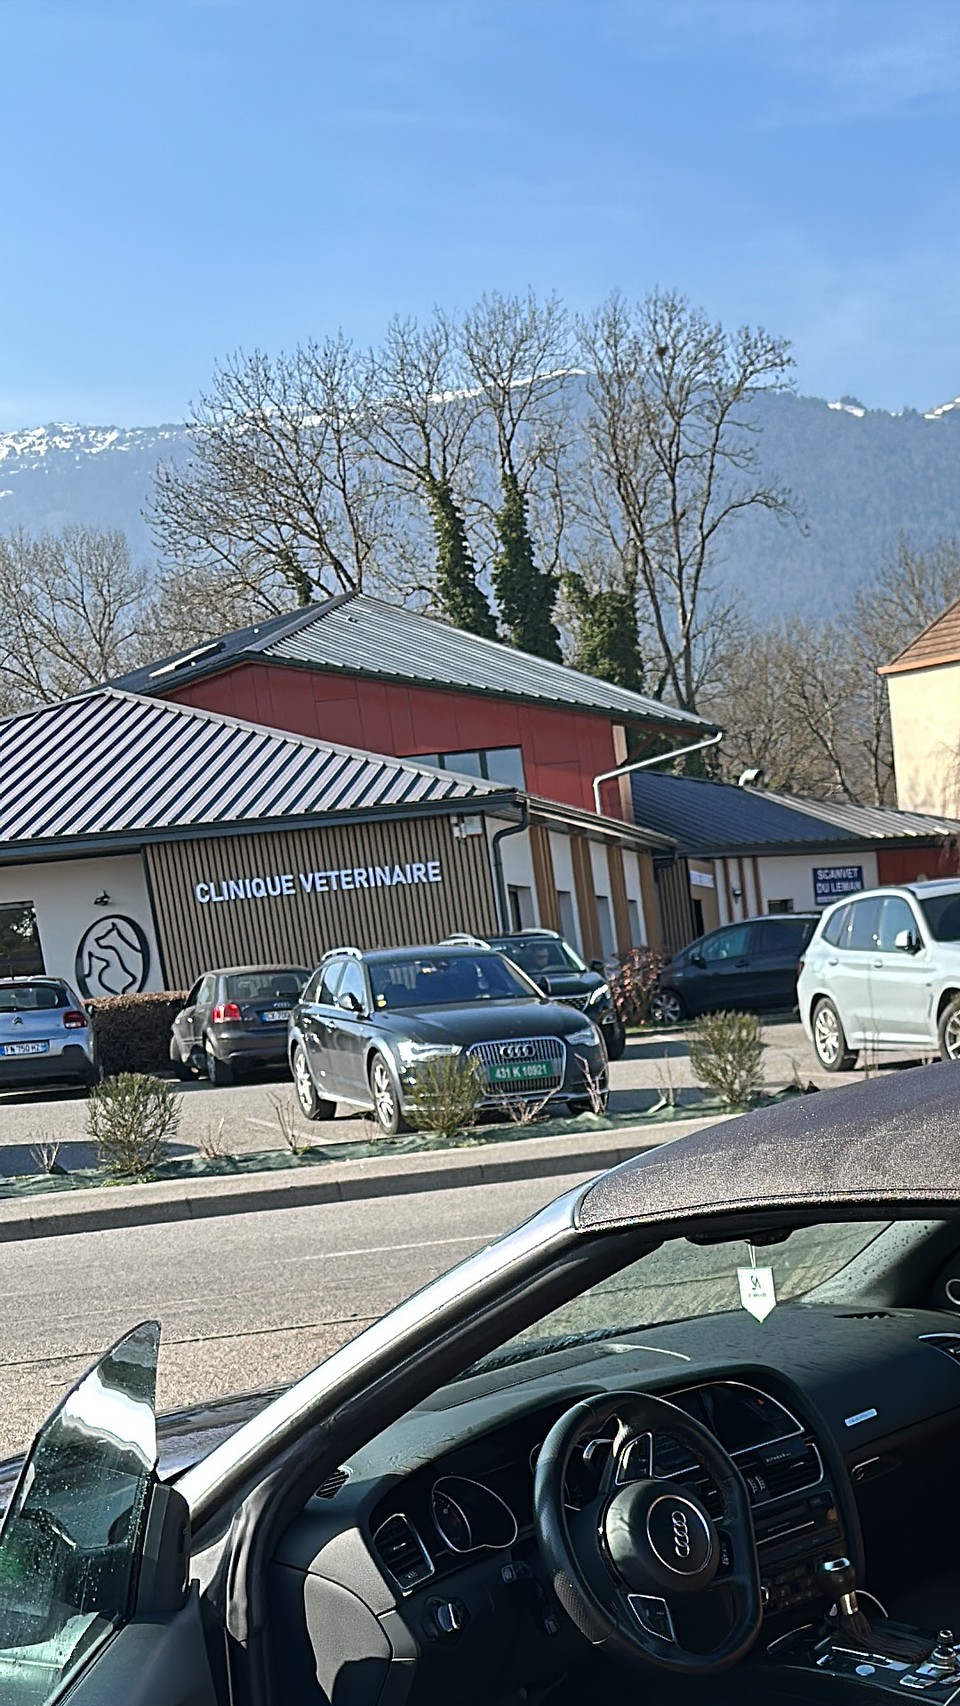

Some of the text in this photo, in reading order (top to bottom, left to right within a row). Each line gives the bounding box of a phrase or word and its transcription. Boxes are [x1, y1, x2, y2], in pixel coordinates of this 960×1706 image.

[195, 861, 442, 903] CLINIQUE VETERINAIRE
[816, 883, 830, 894] DU
[495, 1067, 511, 1079] 431
[512, 1066, 521, 1078] K
